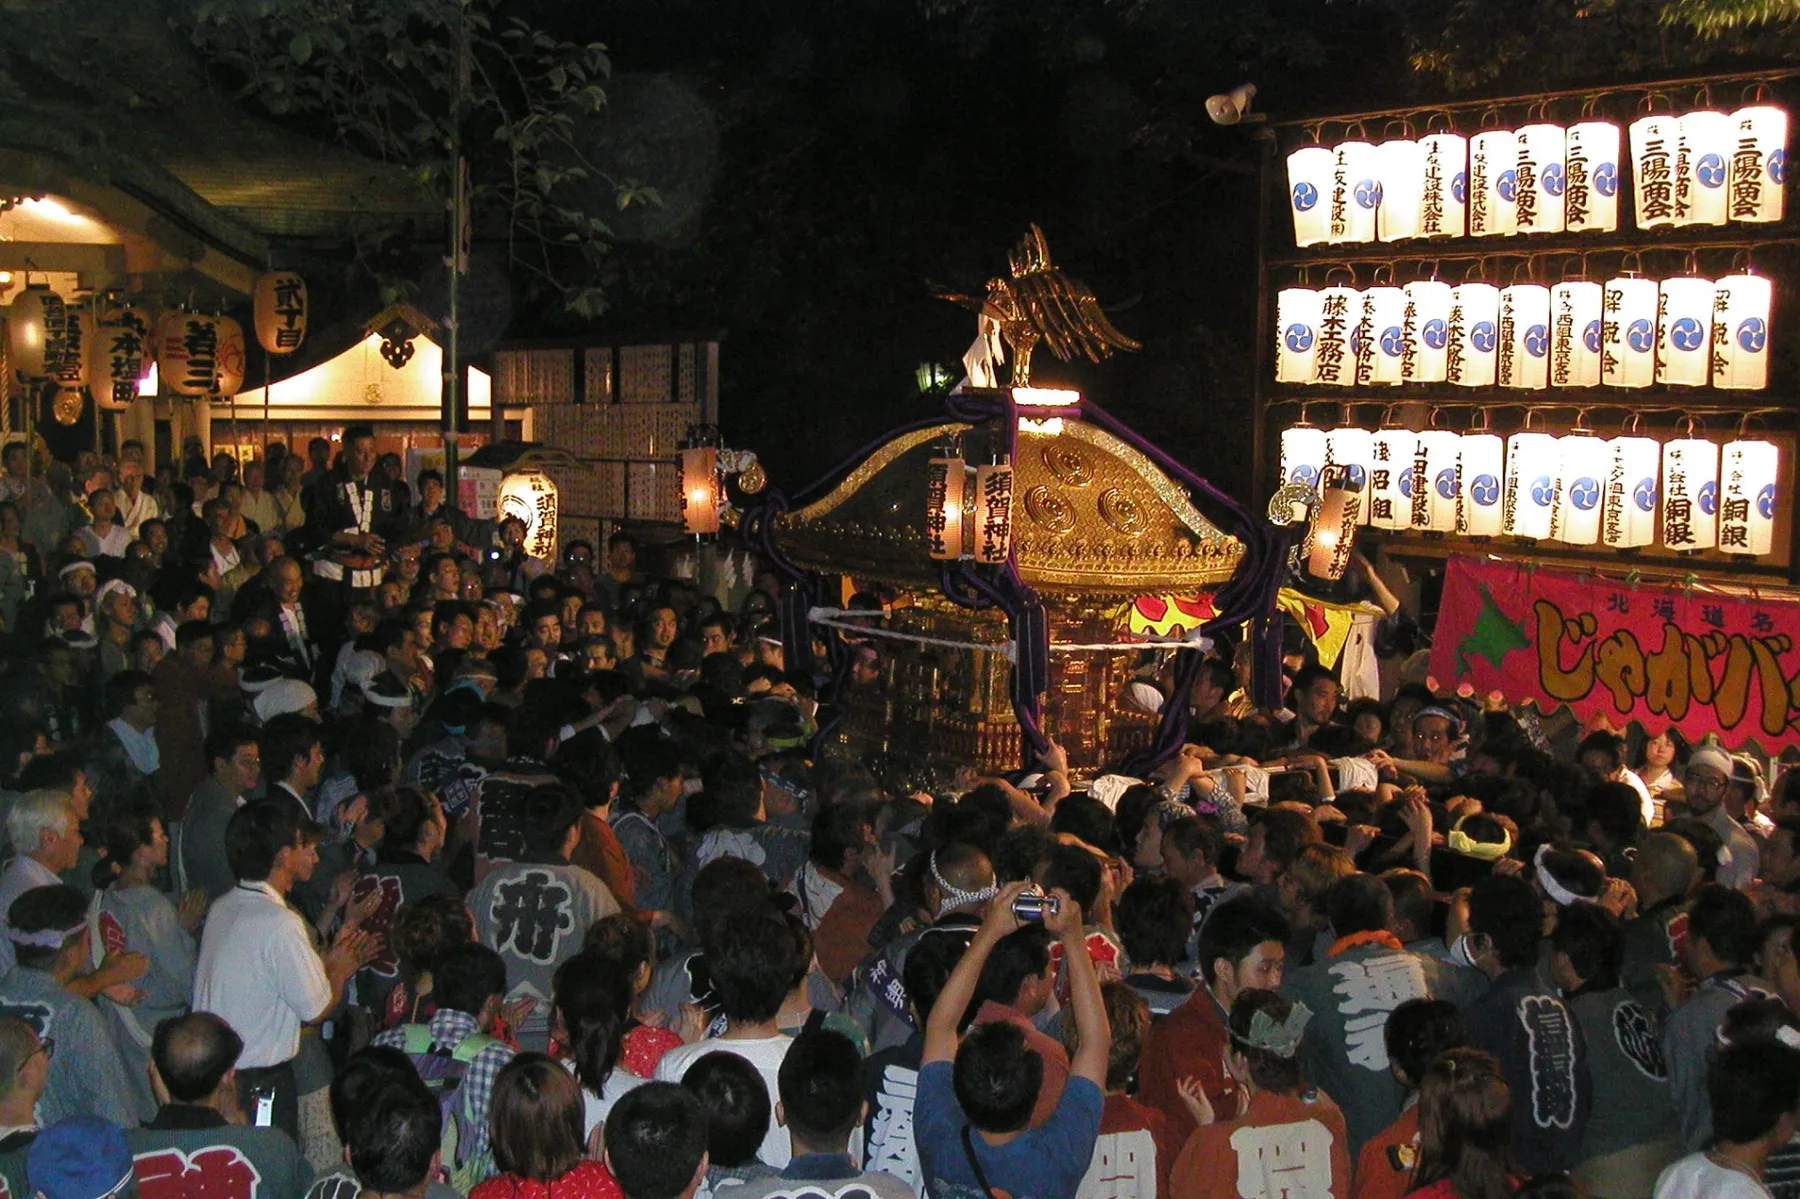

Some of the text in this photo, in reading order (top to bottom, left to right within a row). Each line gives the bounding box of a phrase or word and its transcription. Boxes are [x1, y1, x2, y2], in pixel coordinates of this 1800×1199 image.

[1316, 293, 1349, 382] 藤木工務店
[532, 492, 556, 557] 須賀神社
[982, 470, 1012, 562] 須賀神社
[1534, 599, 1800, 736] じゃがバ
